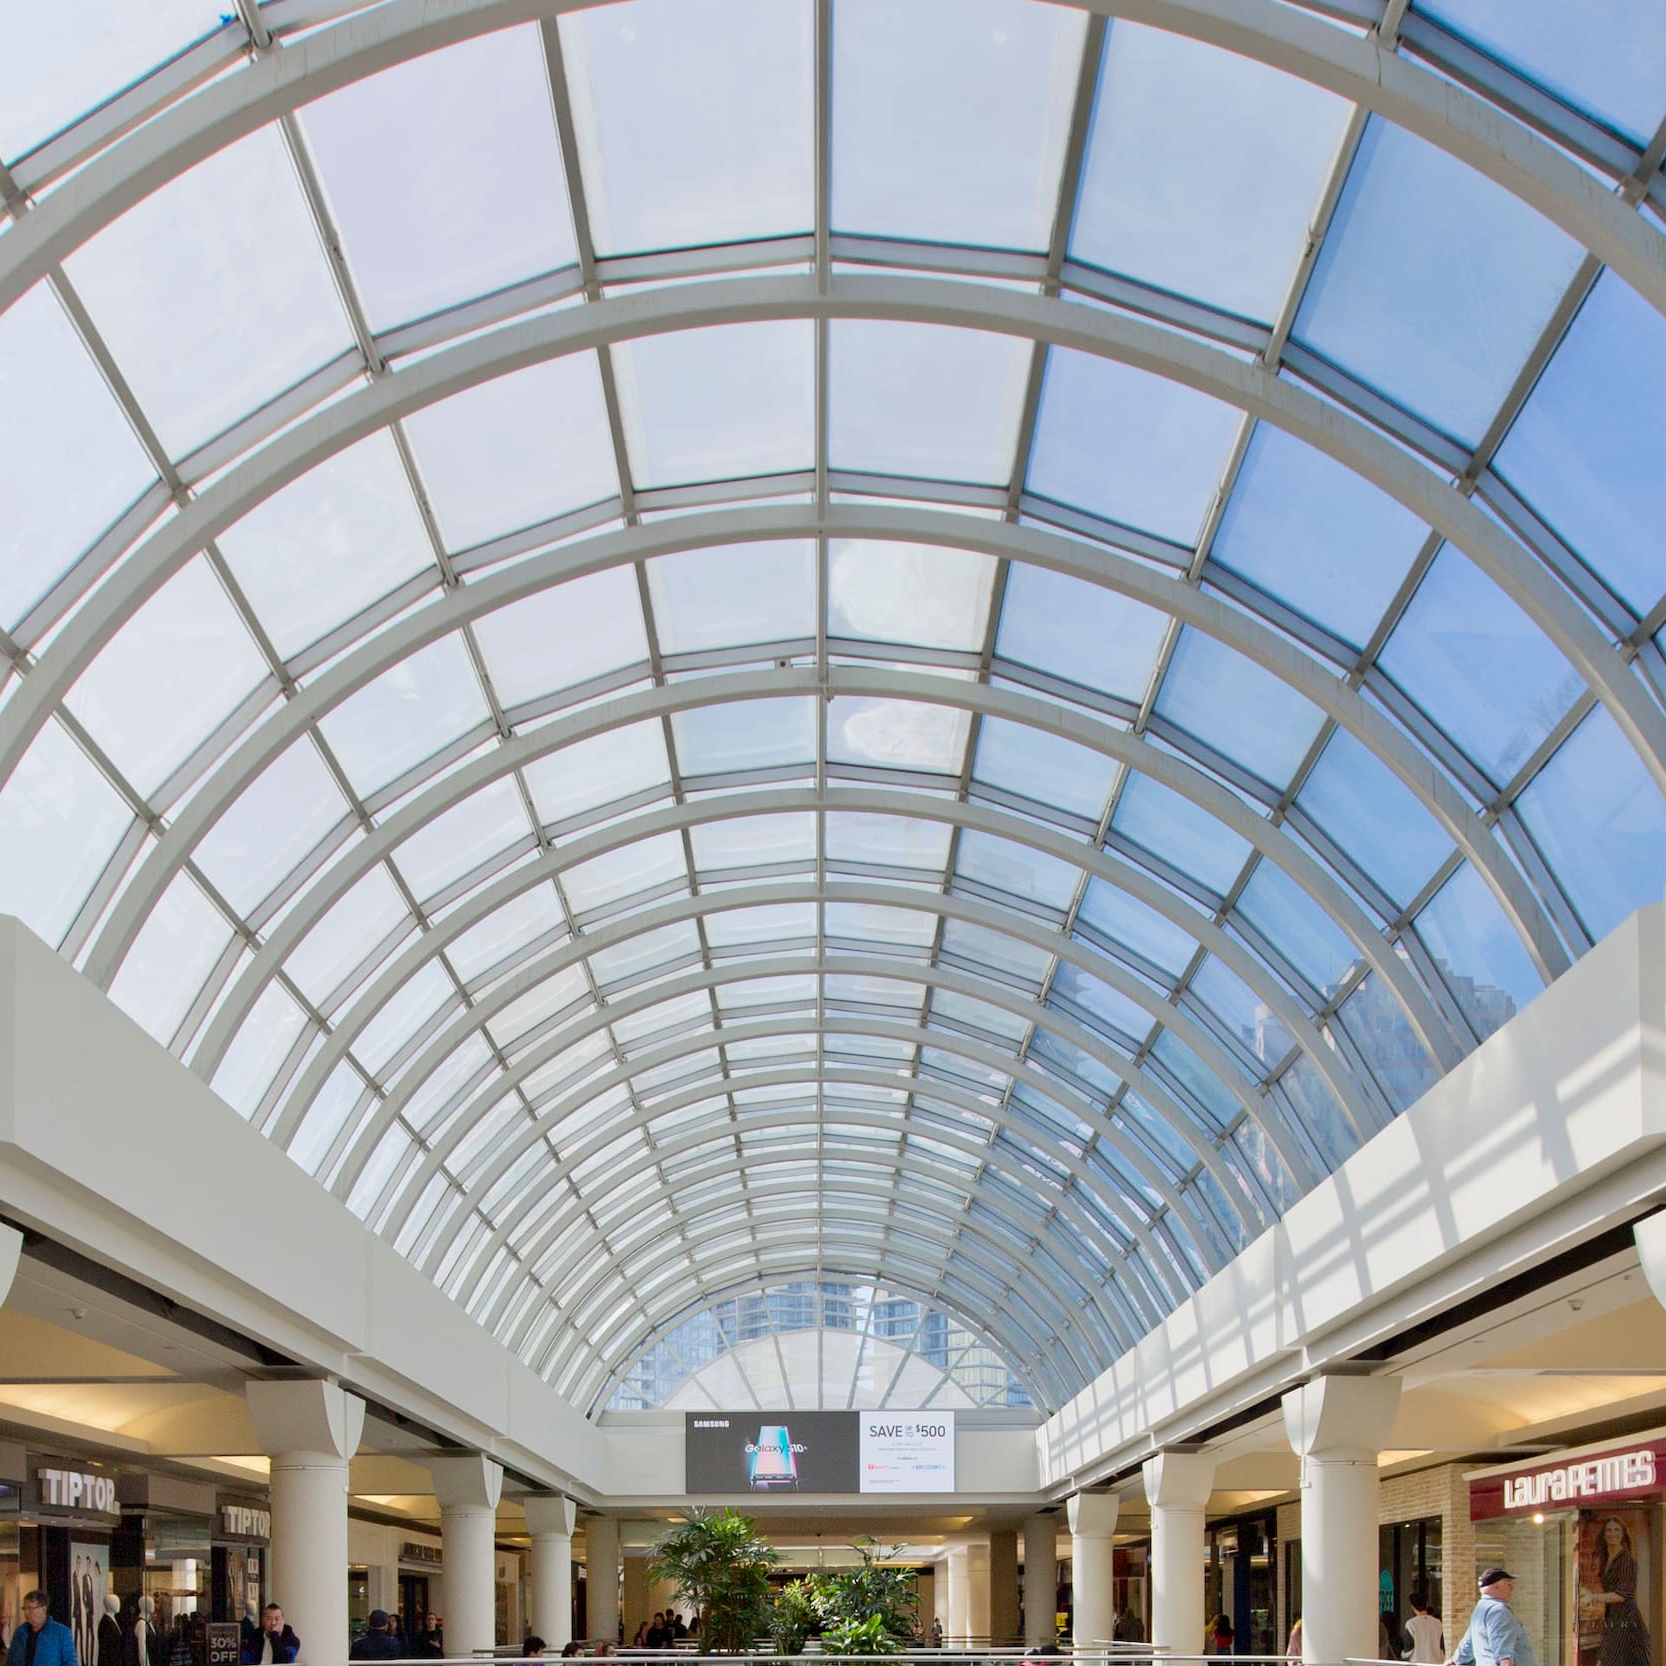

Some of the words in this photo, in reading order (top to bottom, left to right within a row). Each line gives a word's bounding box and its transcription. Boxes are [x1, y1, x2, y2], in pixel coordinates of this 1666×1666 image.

[693, 1420, 730, 1428] SAMSUNG
[869, 1425, 903, 1437] SAVE
[916, 1424, 946, 1437] $500
[745, 1443, 786, 1455] Galaxy
[1504, 1468, 1568, 1509] Laura
[1568, 1449, 1656, 1499] PETITES
[210, 1636, 238, 1649] 30%
[210, 1651, 237, 1663] OFF
